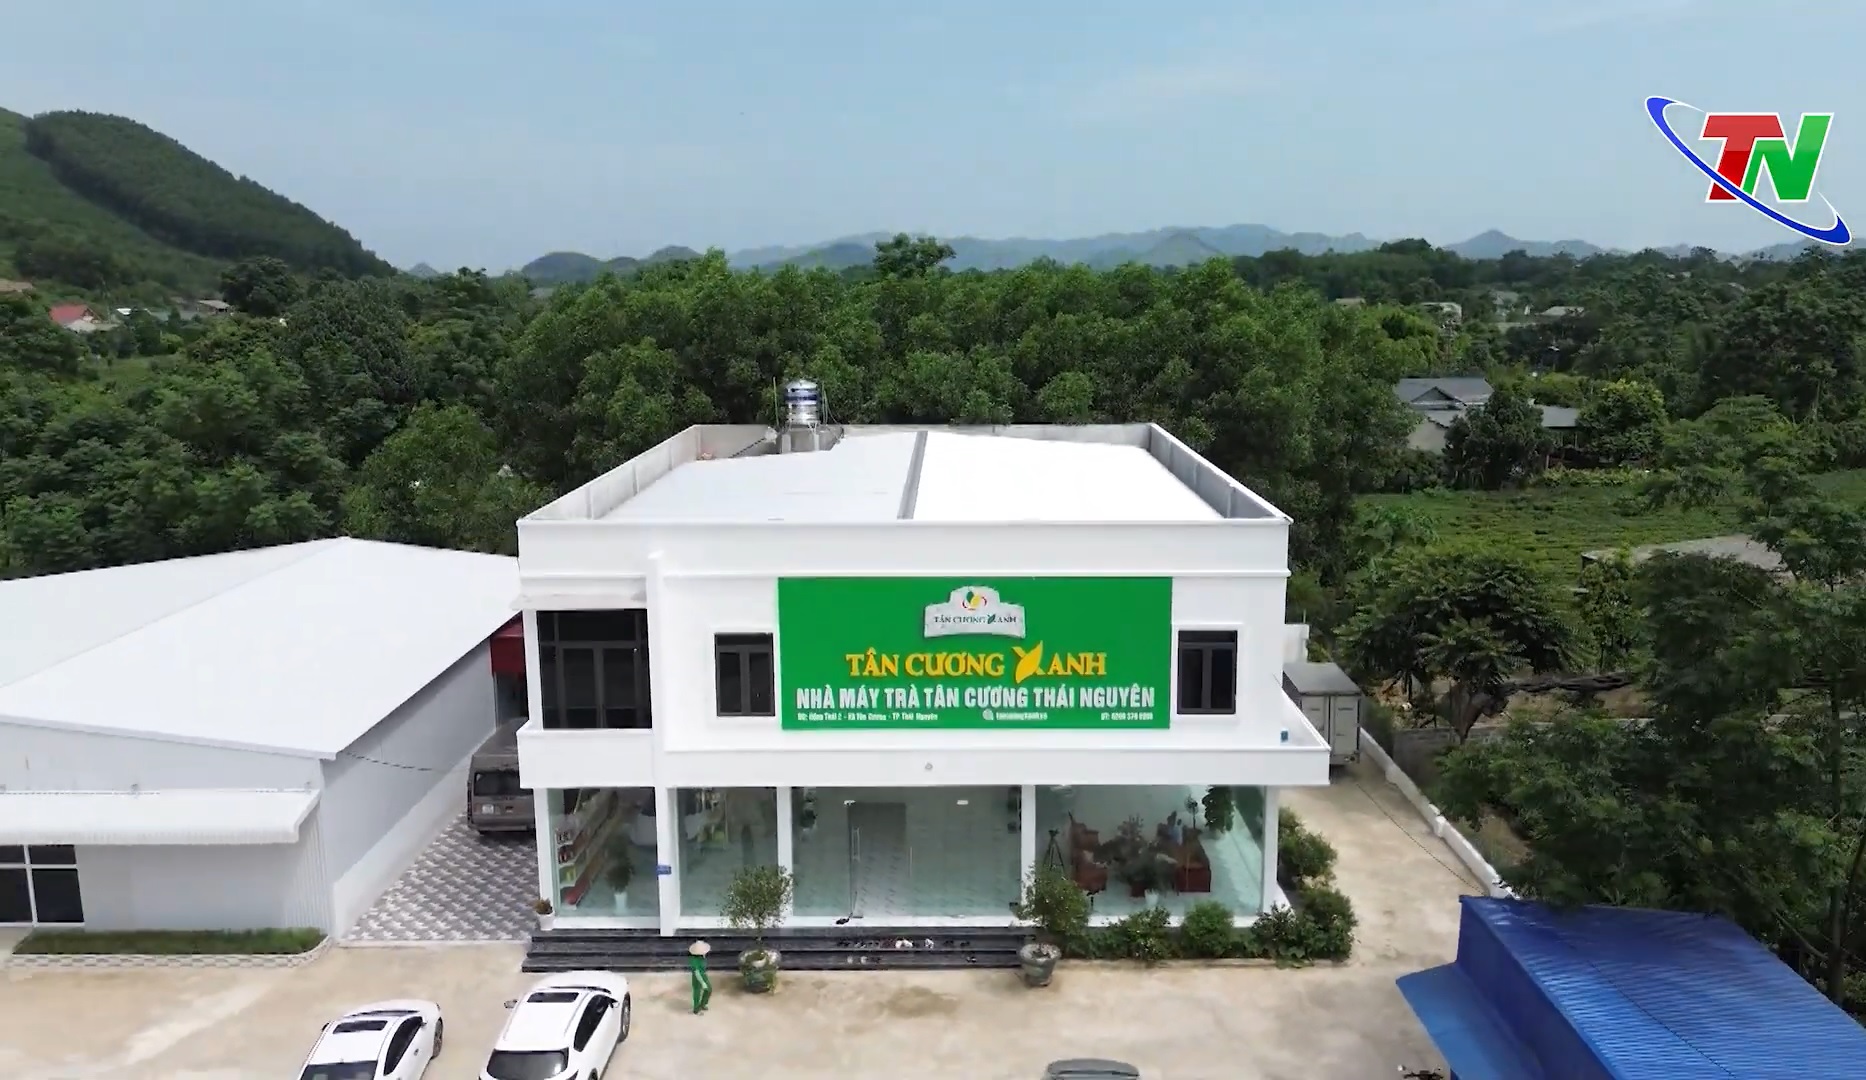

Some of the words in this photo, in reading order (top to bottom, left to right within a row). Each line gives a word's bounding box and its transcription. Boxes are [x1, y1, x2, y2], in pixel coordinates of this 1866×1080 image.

[845, 646, 900, 678] TÂN
[905, 651, 1005, 678] CƯƠNG
[796, 684, 835, 709] NHÀ
[839, 684, 880, 709] MÁY
[884, 684, 920, 709] TRÀ
[923, 684, 960, 709] TÂN
[964, 684, 1029, 709] CƯƠNG
[1033, 683, 1075, 708] THÁI
[1079, 682, 1155, 708] NGUYÊN
